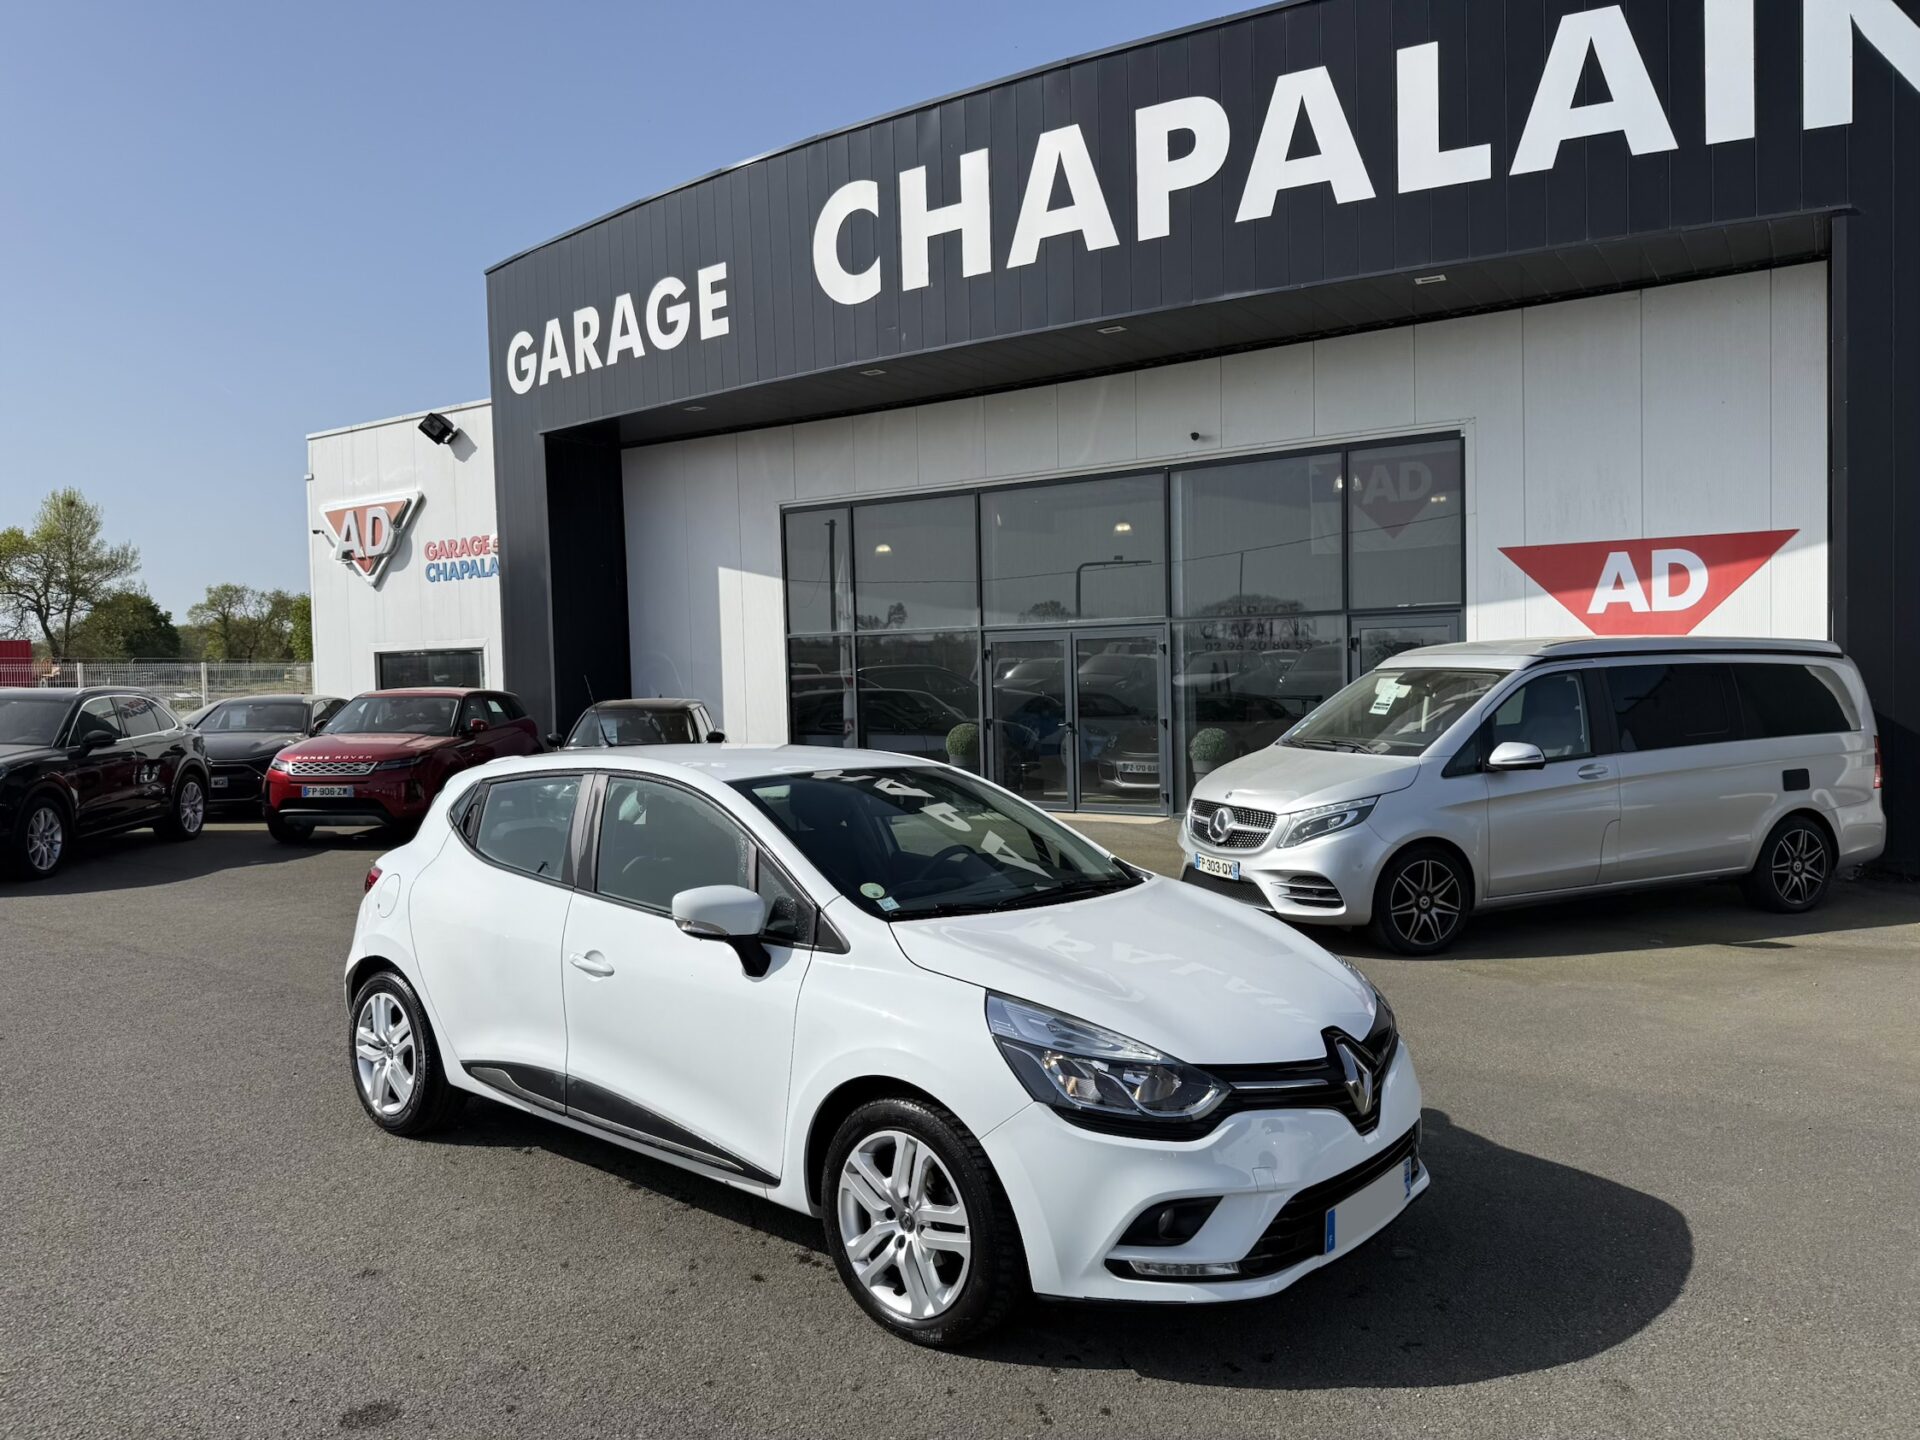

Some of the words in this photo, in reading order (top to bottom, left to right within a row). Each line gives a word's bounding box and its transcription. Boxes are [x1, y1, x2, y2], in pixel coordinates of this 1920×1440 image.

[507, 262, 730, 395] GARAGE
[1361, 461, 1433, 504] AD
[335, 506, 391, 561] AD
[424, 535, 490, 562] GARAGE
[1587, 548, 1709, 614] AD
